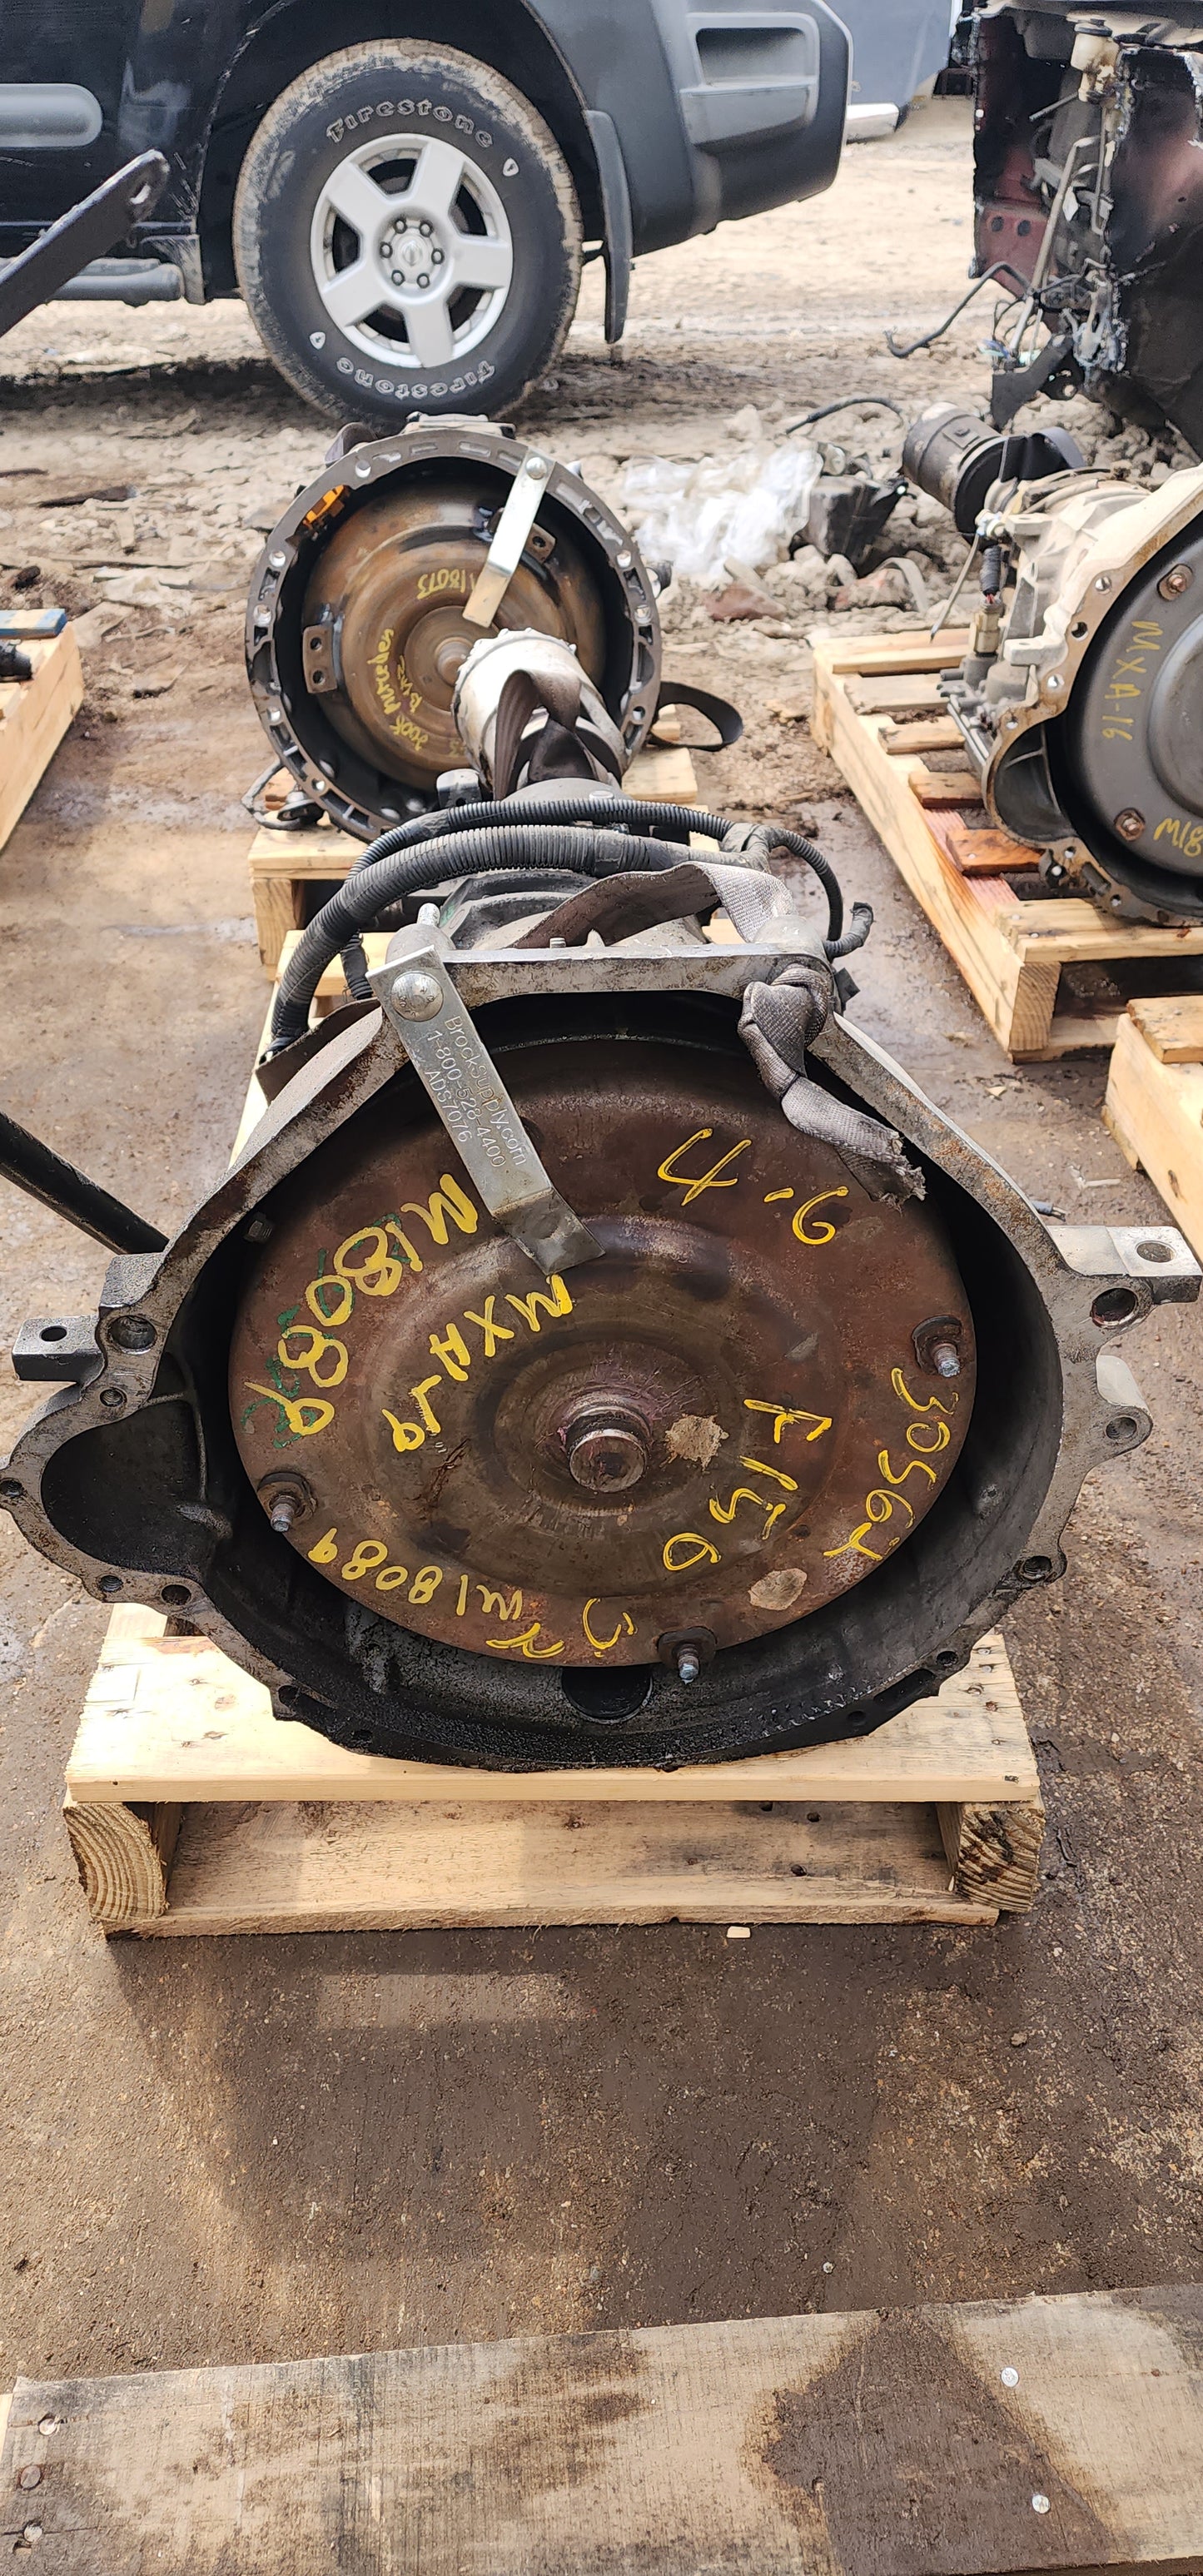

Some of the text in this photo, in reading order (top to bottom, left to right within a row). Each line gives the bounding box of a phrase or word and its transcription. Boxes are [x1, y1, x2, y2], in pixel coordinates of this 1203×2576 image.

[326, 98, 494, 149] Firestone
[336, 356, 496, 400] Firestone
[1101, 620, 1164, 741] MXA-16
[424, 1069, 473, 1143] ADS7076
[426, 1029, 507, 1168] 1-800-528-4400
[445, 1015, 528, 1166] BrockSupply.com
[243, 1173, 479, 1436] M18089
[663, 1398, 833, 1571] F150
